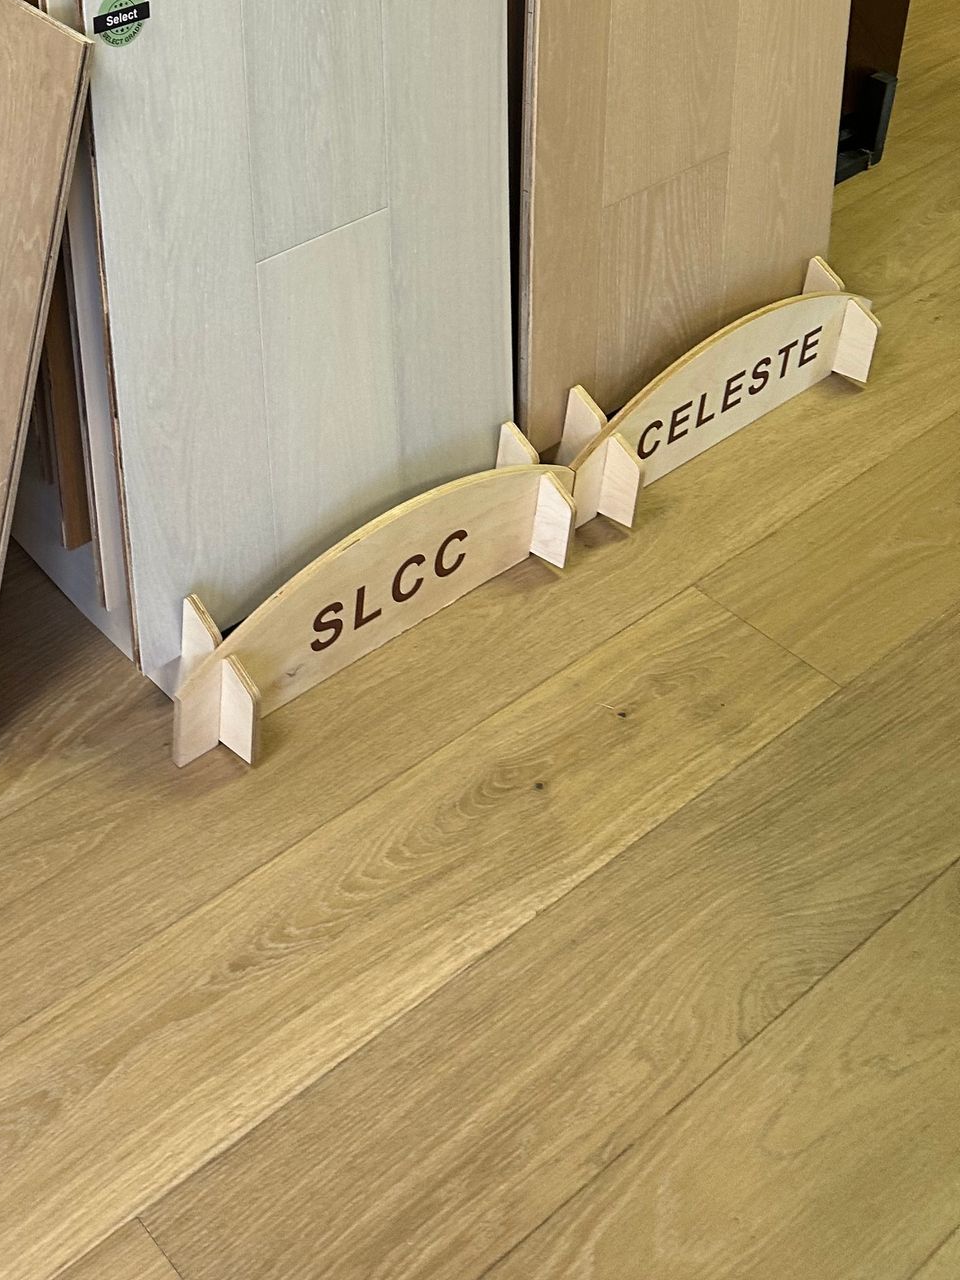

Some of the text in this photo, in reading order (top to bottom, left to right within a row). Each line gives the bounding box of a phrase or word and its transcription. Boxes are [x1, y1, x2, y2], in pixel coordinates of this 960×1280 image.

[102, 22, 143, 46] SELECT GRADE
[106, 8, 138, 27] Select
[637, 326, 824, 461] CELESTE
[310, 528, 469, 653] SLCC
